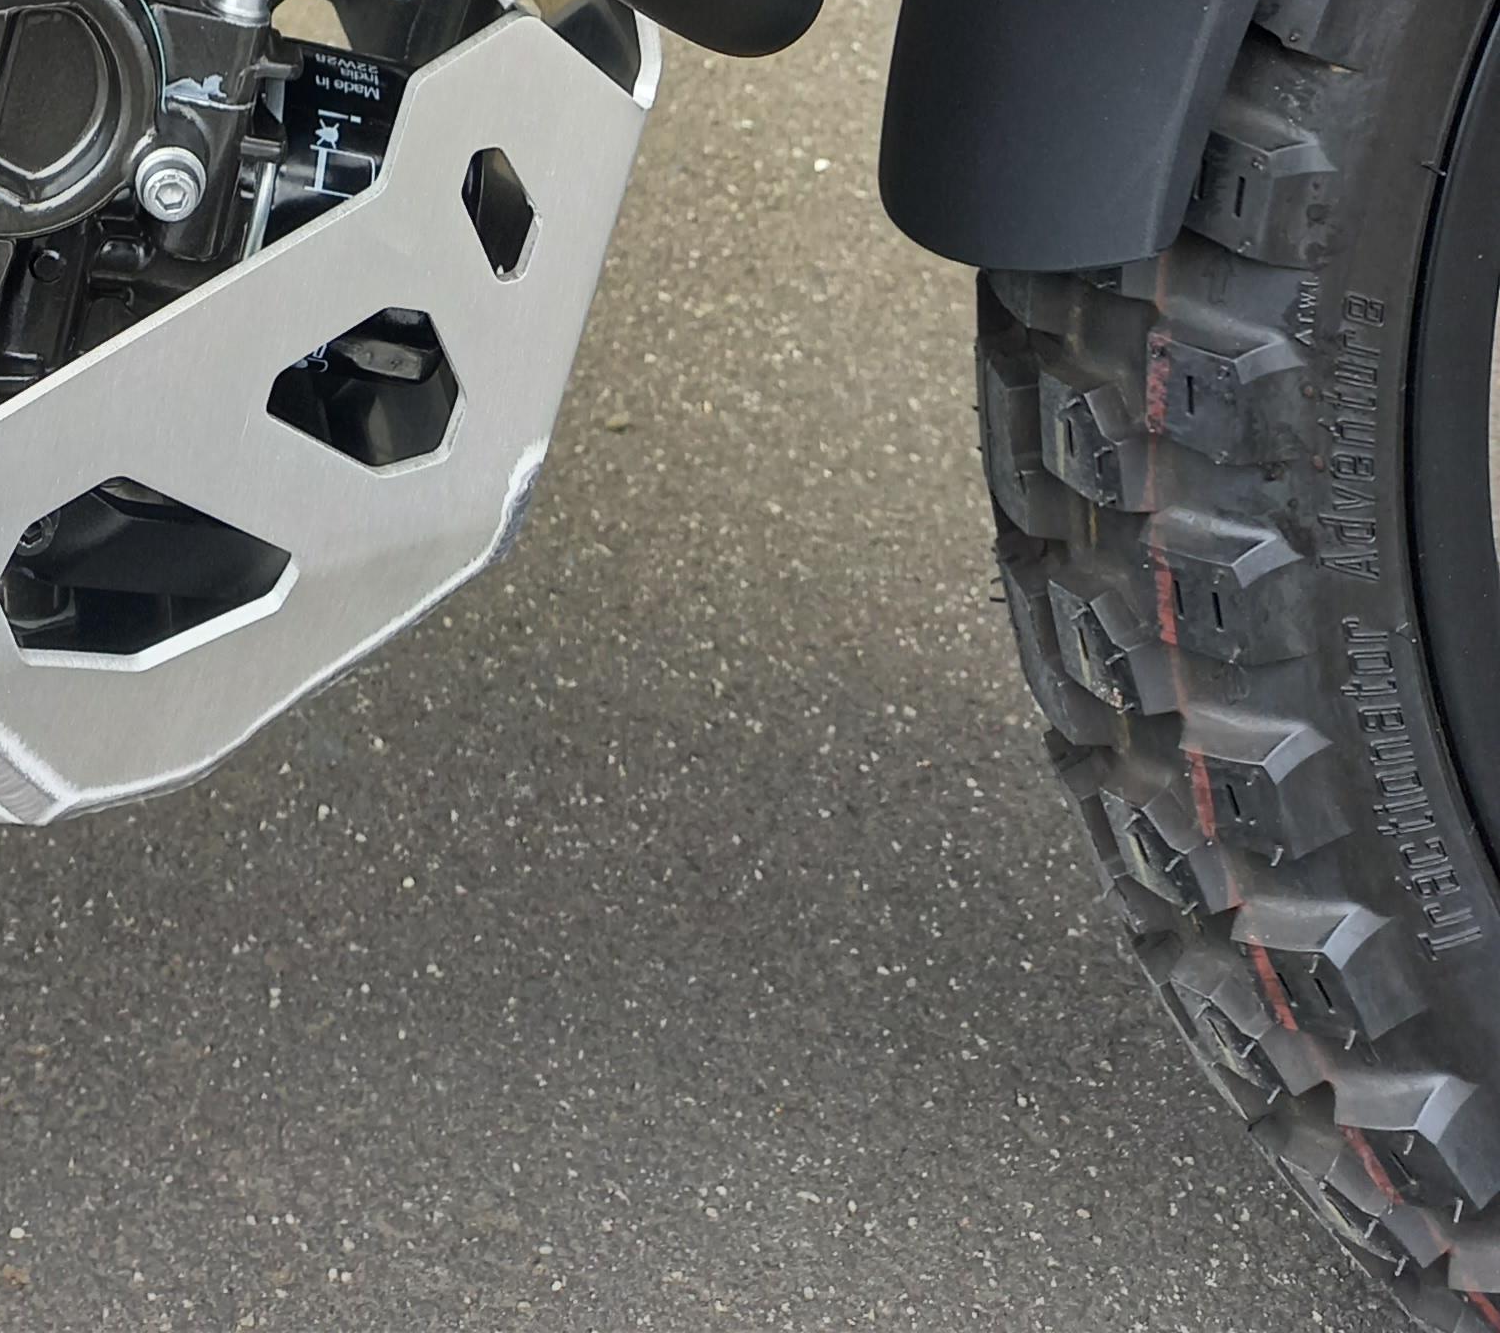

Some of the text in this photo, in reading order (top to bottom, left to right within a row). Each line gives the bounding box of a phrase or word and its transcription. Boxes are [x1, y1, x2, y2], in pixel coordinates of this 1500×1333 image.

[315, 74, 380, 101] Made in
[340, 66, 379, 86] India
[1317, 289, 1482, 962] Tractionator Adventure
